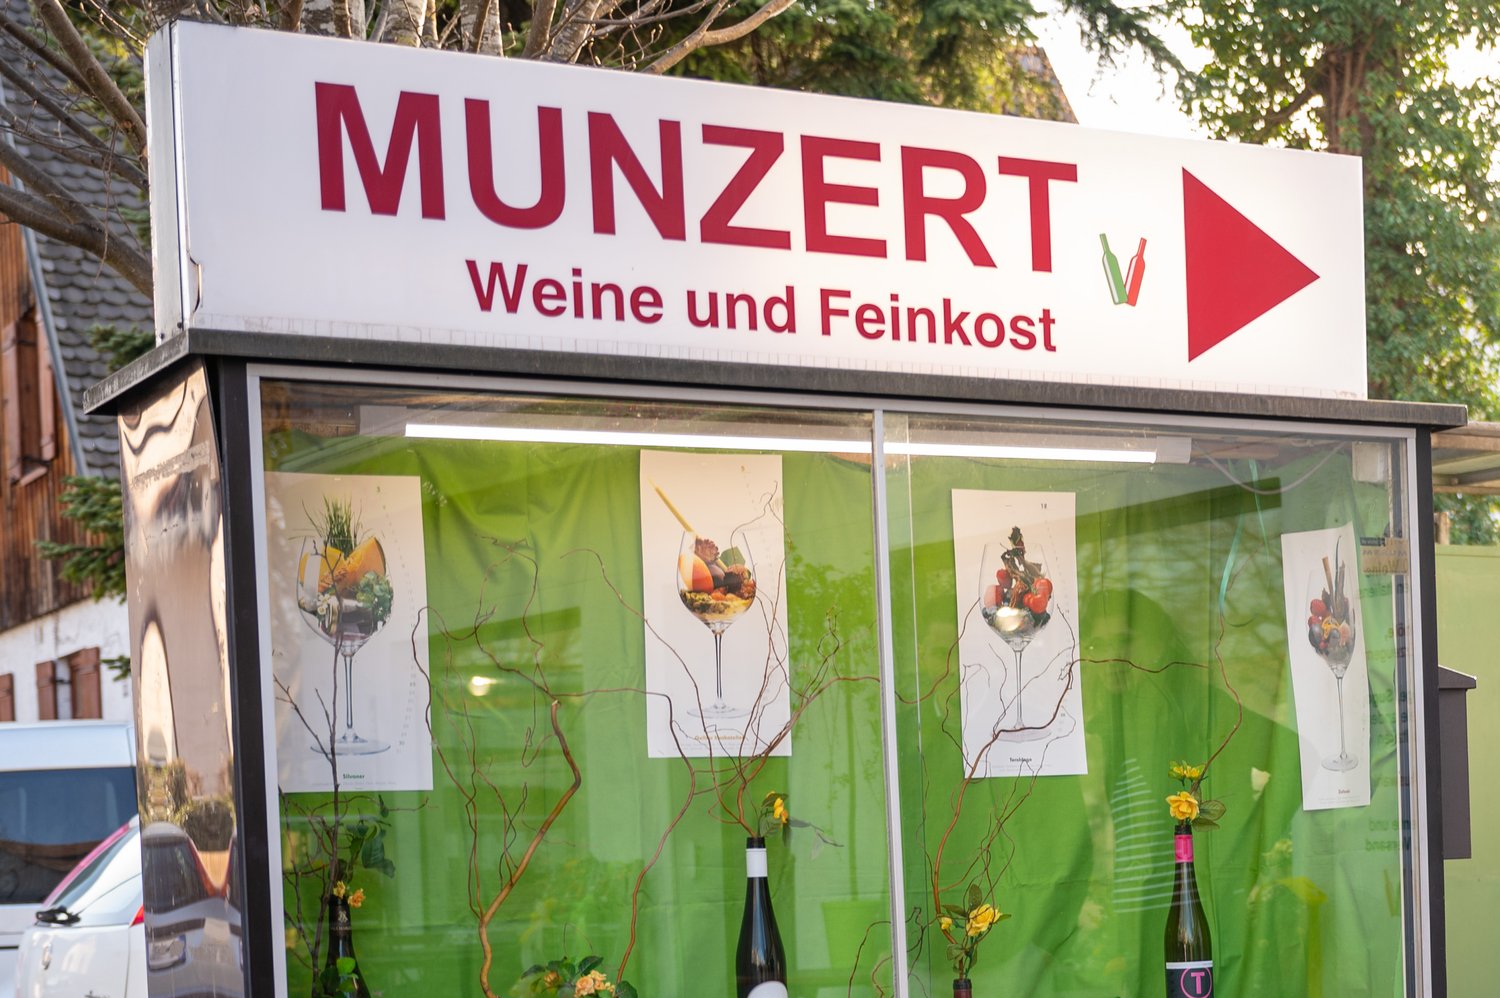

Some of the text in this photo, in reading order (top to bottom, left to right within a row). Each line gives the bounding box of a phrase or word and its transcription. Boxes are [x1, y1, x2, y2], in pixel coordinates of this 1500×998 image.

[315, 81, 1078, 273] MUNZERT
[465, 260, 1057, 354] Weine und Feinkost
[1190, 972, 1205, 995] T
